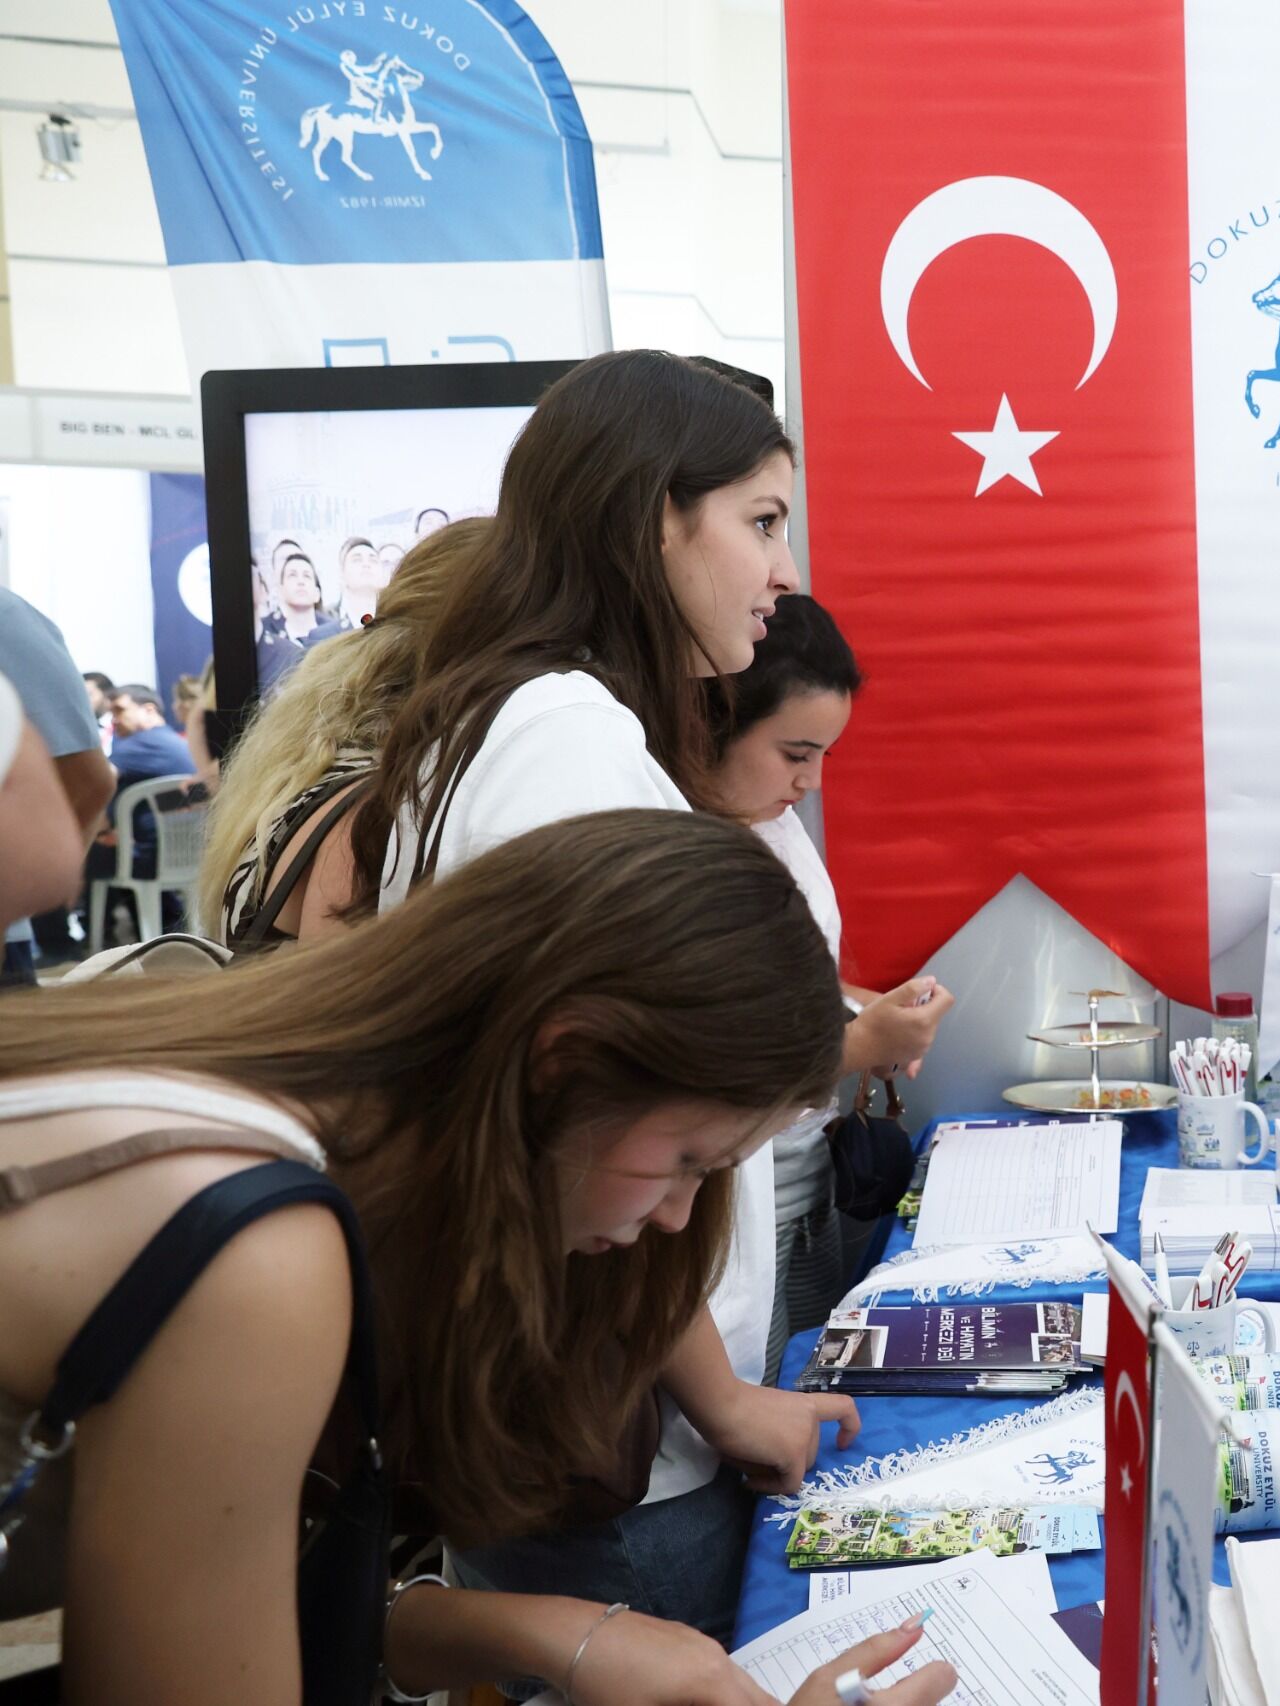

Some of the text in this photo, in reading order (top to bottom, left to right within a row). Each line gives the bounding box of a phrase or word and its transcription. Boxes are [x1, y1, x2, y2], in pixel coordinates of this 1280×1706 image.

[1266, 1385, 1275, 1408] UNIVE
[1253, 1447, 1264, 1499] UNIVERSITY
[1258, 1431, 1277, 1513] DOKUZ EYLÜL
